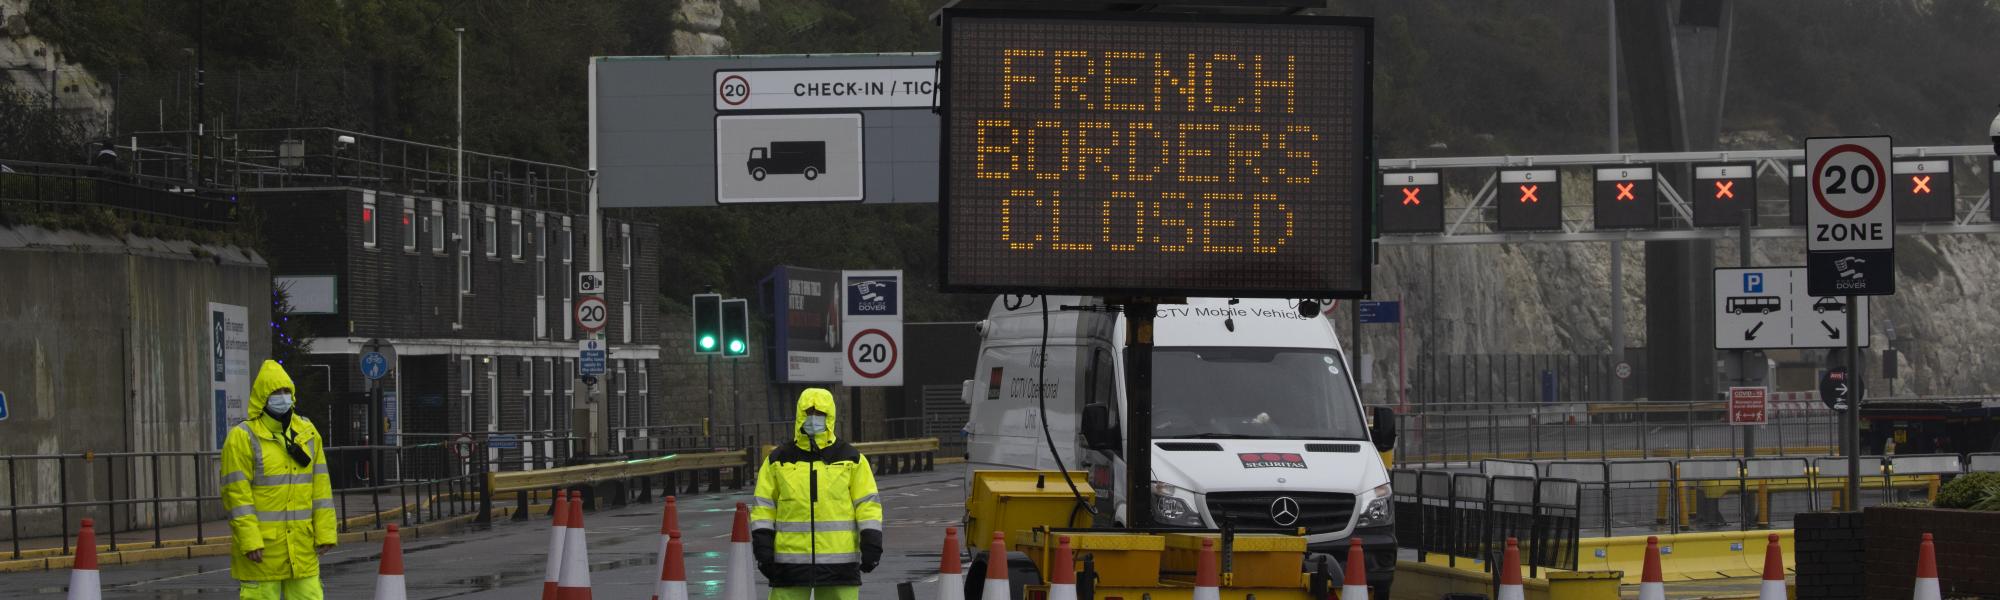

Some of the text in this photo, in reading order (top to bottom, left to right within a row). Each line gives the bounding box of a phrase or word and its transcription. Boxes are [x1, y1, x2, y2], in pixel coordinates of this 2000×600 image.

[725, 83, 746, 97] 20
[793, 81, 884, 97] CHECK-IN
[890, 80, 897, 97] /
[1003, 48, 1296, 114] FRENCH
[976, 117, 1320, 184] BORDERS
[1721, 168, 1727, 176] E
[1917, 163, 1924, 171] G
[1824, 164, 1875, 195] 20
[1001, 188, 1294, 254] CLOSED
[1816, 222, 1883, 242] ZONE
[1748, 275, 1760, 291] P
[581, 305, 605, 322] 20
[1195, 307, 1247, 318] Mobile
[1251, 307, 1307, 321] Vehicle
[858, 343, 887, 363] 20
[1027, 377, 1060, 403] Opertional
